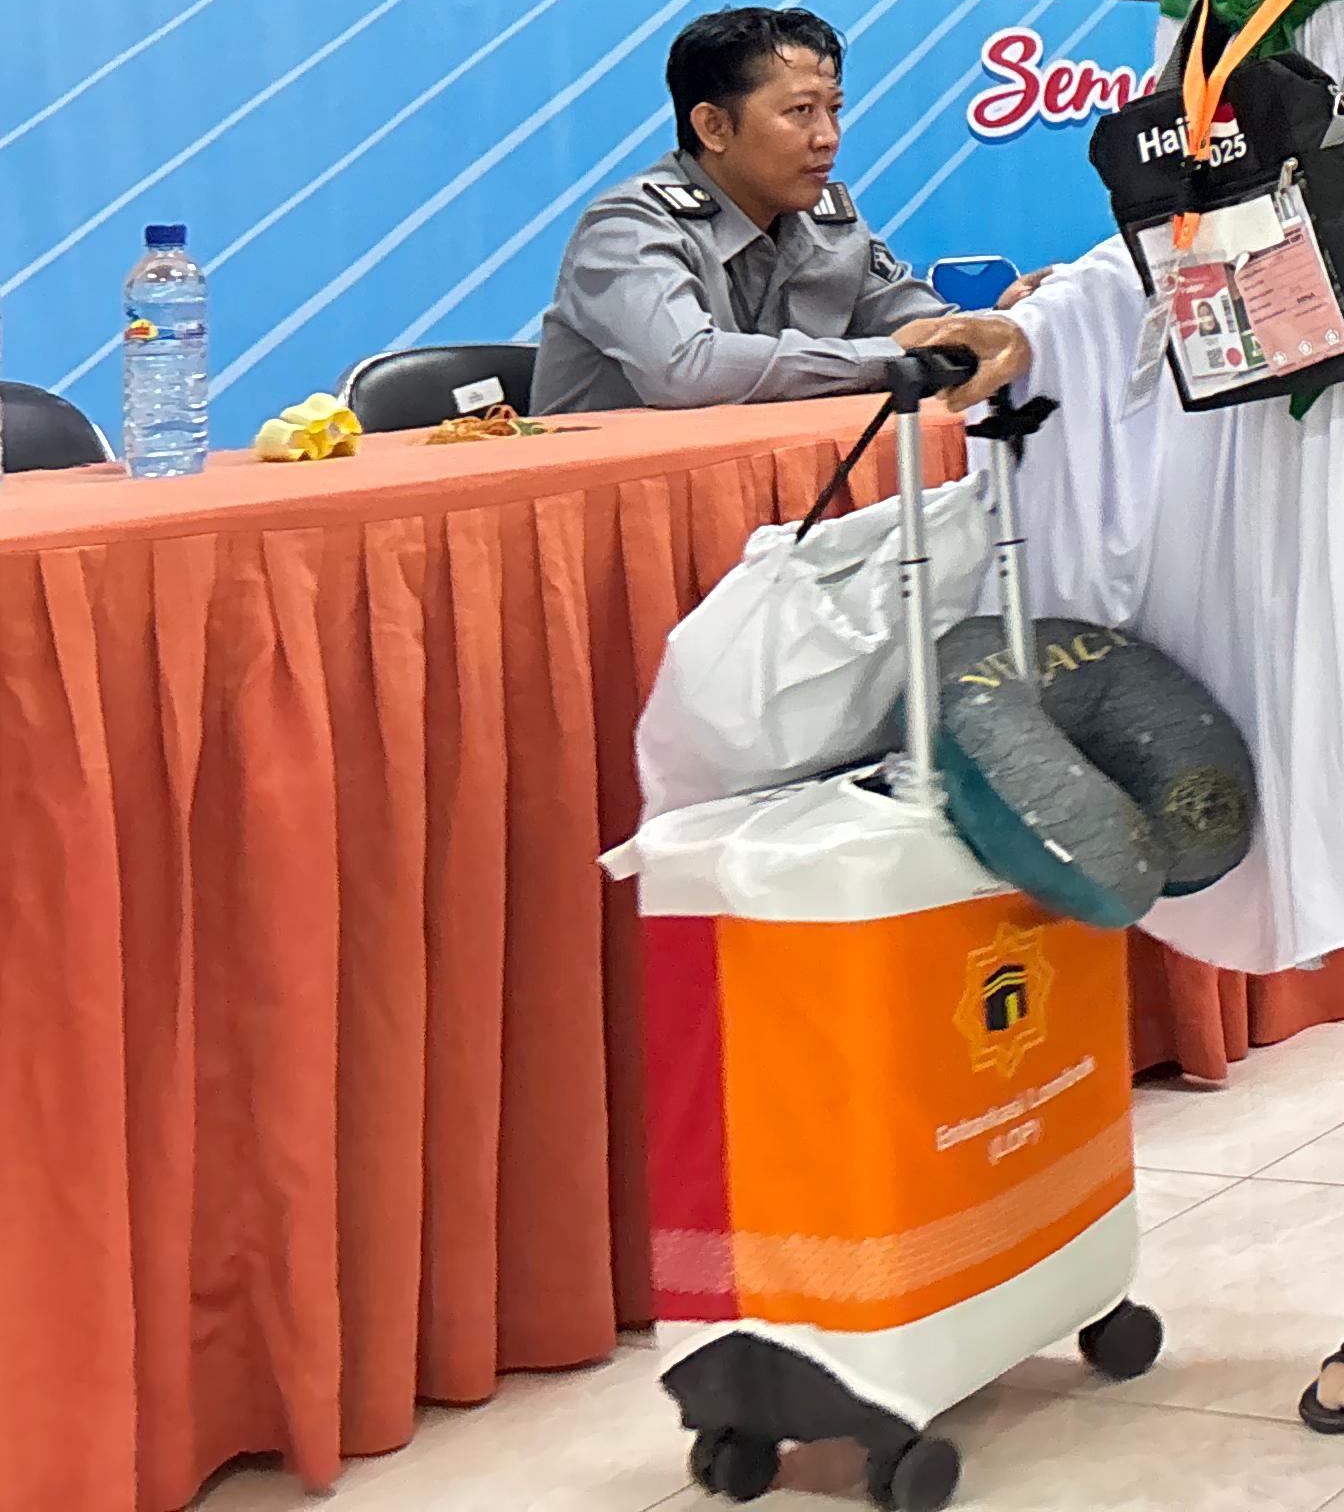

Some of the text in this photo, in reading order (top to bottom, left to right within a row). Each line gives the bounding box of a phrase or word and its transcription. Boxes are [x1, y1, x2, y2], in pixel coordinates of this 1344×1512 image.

[974, 35, 1157, 128] Sem
[1137, 117, 1190, 164] Haj
[1196, 133, 1247, 170] 025
